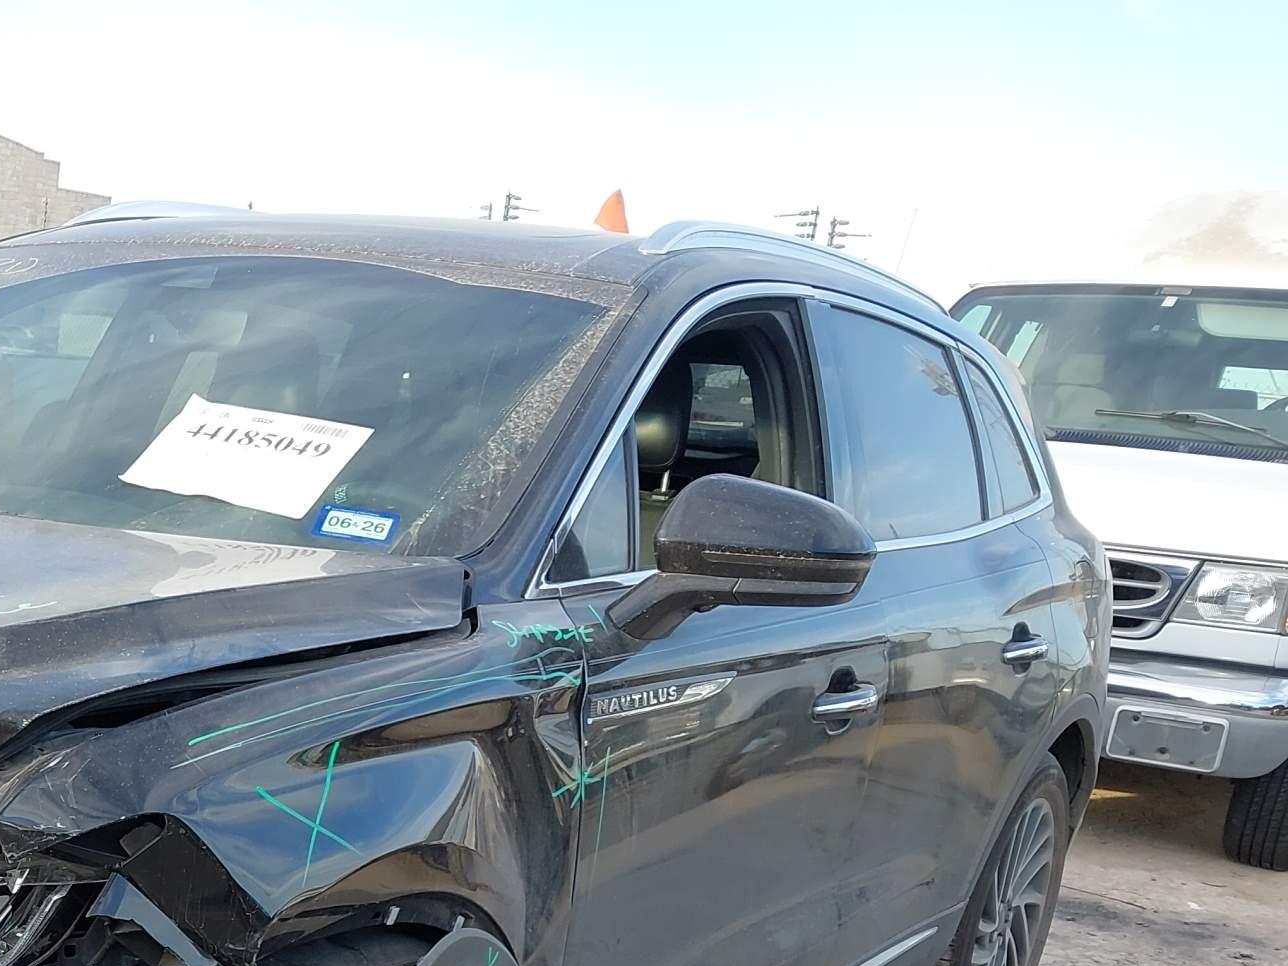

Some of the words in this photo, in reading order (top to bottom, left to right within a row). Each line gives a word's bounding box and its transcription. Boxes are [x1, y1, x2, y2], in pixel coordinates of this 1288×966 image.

[186, 423, 332, 458] 44185049
[327, 515, 352, 531] 06
[361, 519, 387, 534] 26
[596, 686, 679, 716] NAUTILUS
